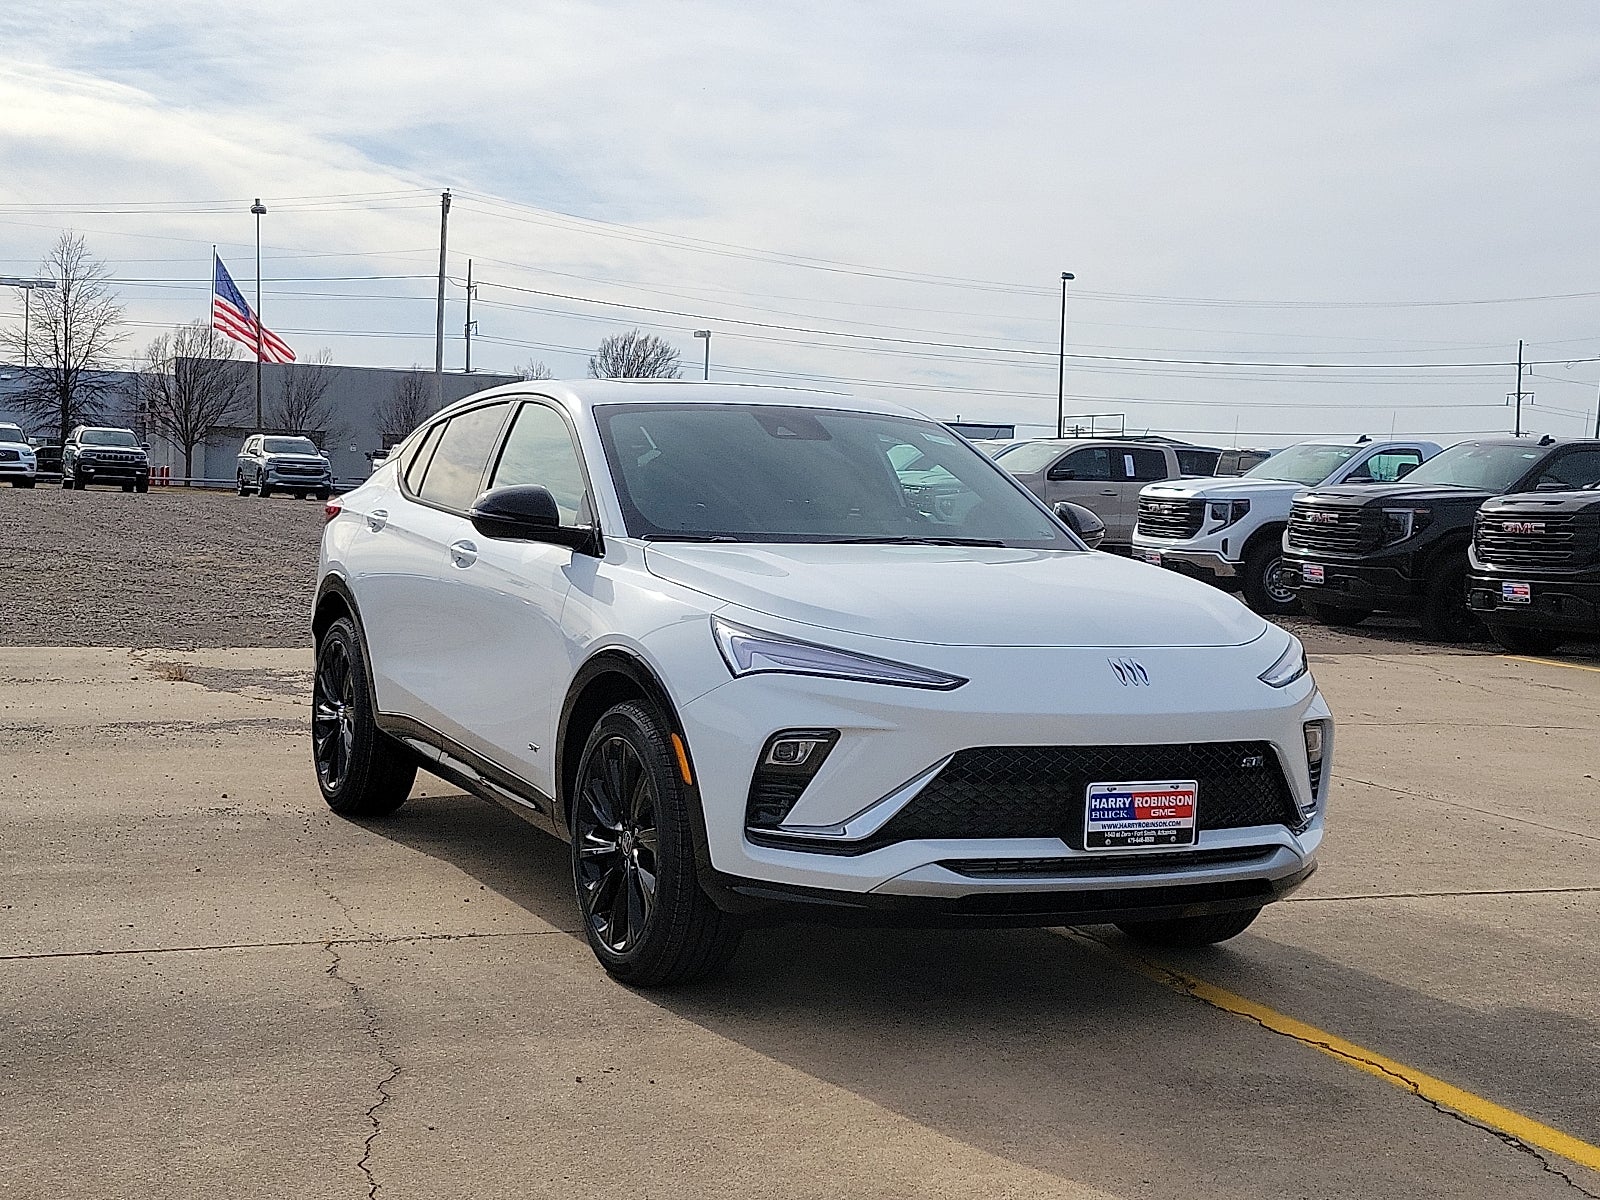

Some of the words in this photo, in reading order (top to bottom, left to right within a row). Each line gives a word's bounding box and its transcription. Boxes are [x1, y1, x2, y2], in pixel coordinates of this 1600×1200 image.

[1306, 512, 1339, 523] GMC
[1502, 522, 1546, 534] GMC
[1091, 798, 1132, 809] HARRY
[1134, 795, 1192, 807] ROBINSON
[1091, 810, 1128, 818] BUICK
[1150, 808, 1176, 816] GMC
[1102, 821, 1181, 829] WWW.HARRYROBINSON.COM
